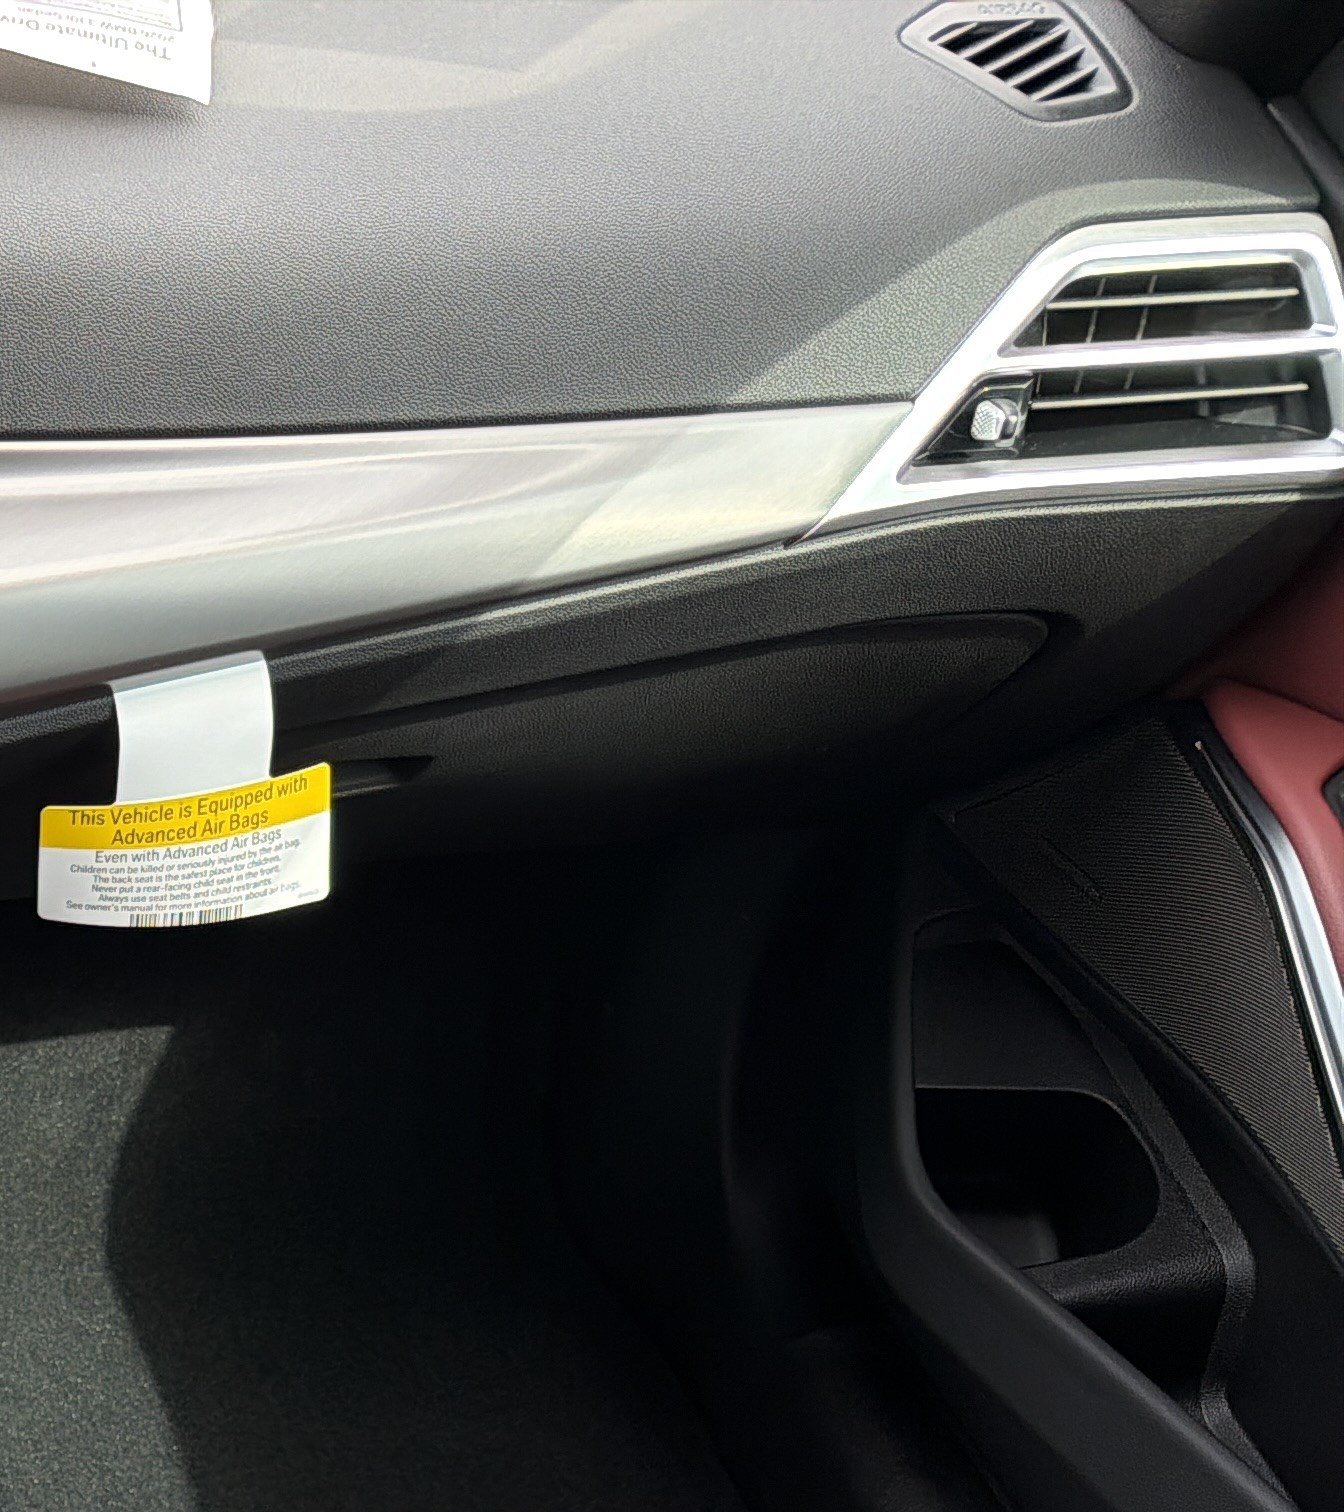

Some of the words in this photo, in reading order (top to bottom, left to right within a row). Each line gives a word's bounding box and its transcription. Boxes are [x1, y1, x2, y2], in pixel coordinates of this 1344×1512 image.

[68, 809, 106, 826] This
[109, 805, 174, 825] Vehicle
[178, 802, 193, 819] is
[197, 782, 274, 817] Equipped
[276, 774, 308, 798] with
[111, 822, 198, 846] Advanced
[200, 819, 226, 838] Air
[229, 809, 270, 832] Bags
[95, 850, 128, 864] Even
[130, 848, 160, 863] with
[162, 839, 229, 860] Advanced
[230, 836, 249, 851] Air
[251, 828, 282, 847] Bags
[69, 863, 108, 874] Children
[109, 866, 126, 875] can
[127, 865, 139, 874] be
[140, 863, 164, 873] killed
[165, 864, 176, 872] or
[94, 874, 110, 883] The
[112, 875, 133, 884] back
[135, 875, 154, 883] seat
[155, 874, 163, 883] is
[164, 873, 180, 882] the
[91, 884, 117, 894] Never
[118, 885, 134, 895] put
[98, 893, 129, 903] Always
[130, 895, 147, 903] use
[148, 893, 168, 903] seat
[66, 899, 84, 910] See
[84, 903, 119, 912] owner's
[120, 903, 154, 912] manual
[154, 903, 168, 911] for
